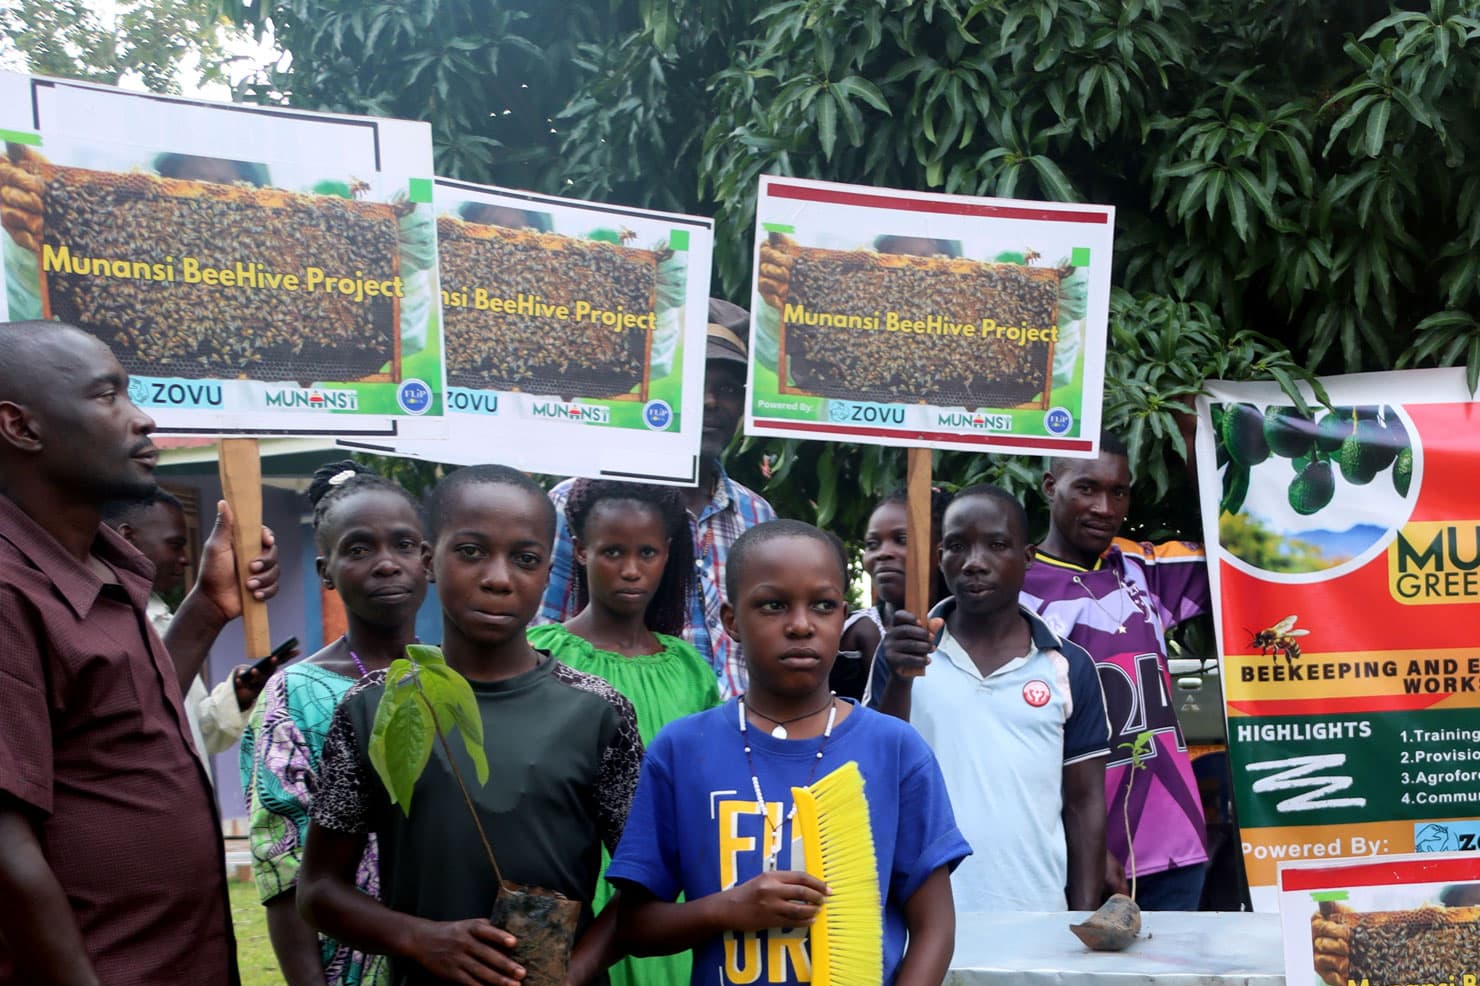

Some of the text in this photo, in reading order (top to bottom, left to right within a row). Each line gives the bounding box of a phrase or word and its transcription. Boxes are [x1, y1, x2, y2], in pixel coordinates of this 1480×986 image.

[42, 244, 175, 283] Munansi
[183, 257, 299, 291] BeeHive
[307, 267, 405, 302] Project
[474, 288, 569, 321] BeeHive
[576, 301, 657, 332] Project
[784, 303, 1059, 346] Munansi BeeHive Project
[152, 382, 222, 406] ZOVU
[758, 400, 797, 411] Powered
[852, 406, 905, 424] ZOVU
[1241, 661, 1397, 682] BEEKEEPING
[1407, 657, 1458, 676] AND
[1238, 721, 1372, 742] HIGHLIGHTS
[1400, 729, 1480, 743] 1.Training
[1242, 837, 1388, 859] Powered By:
